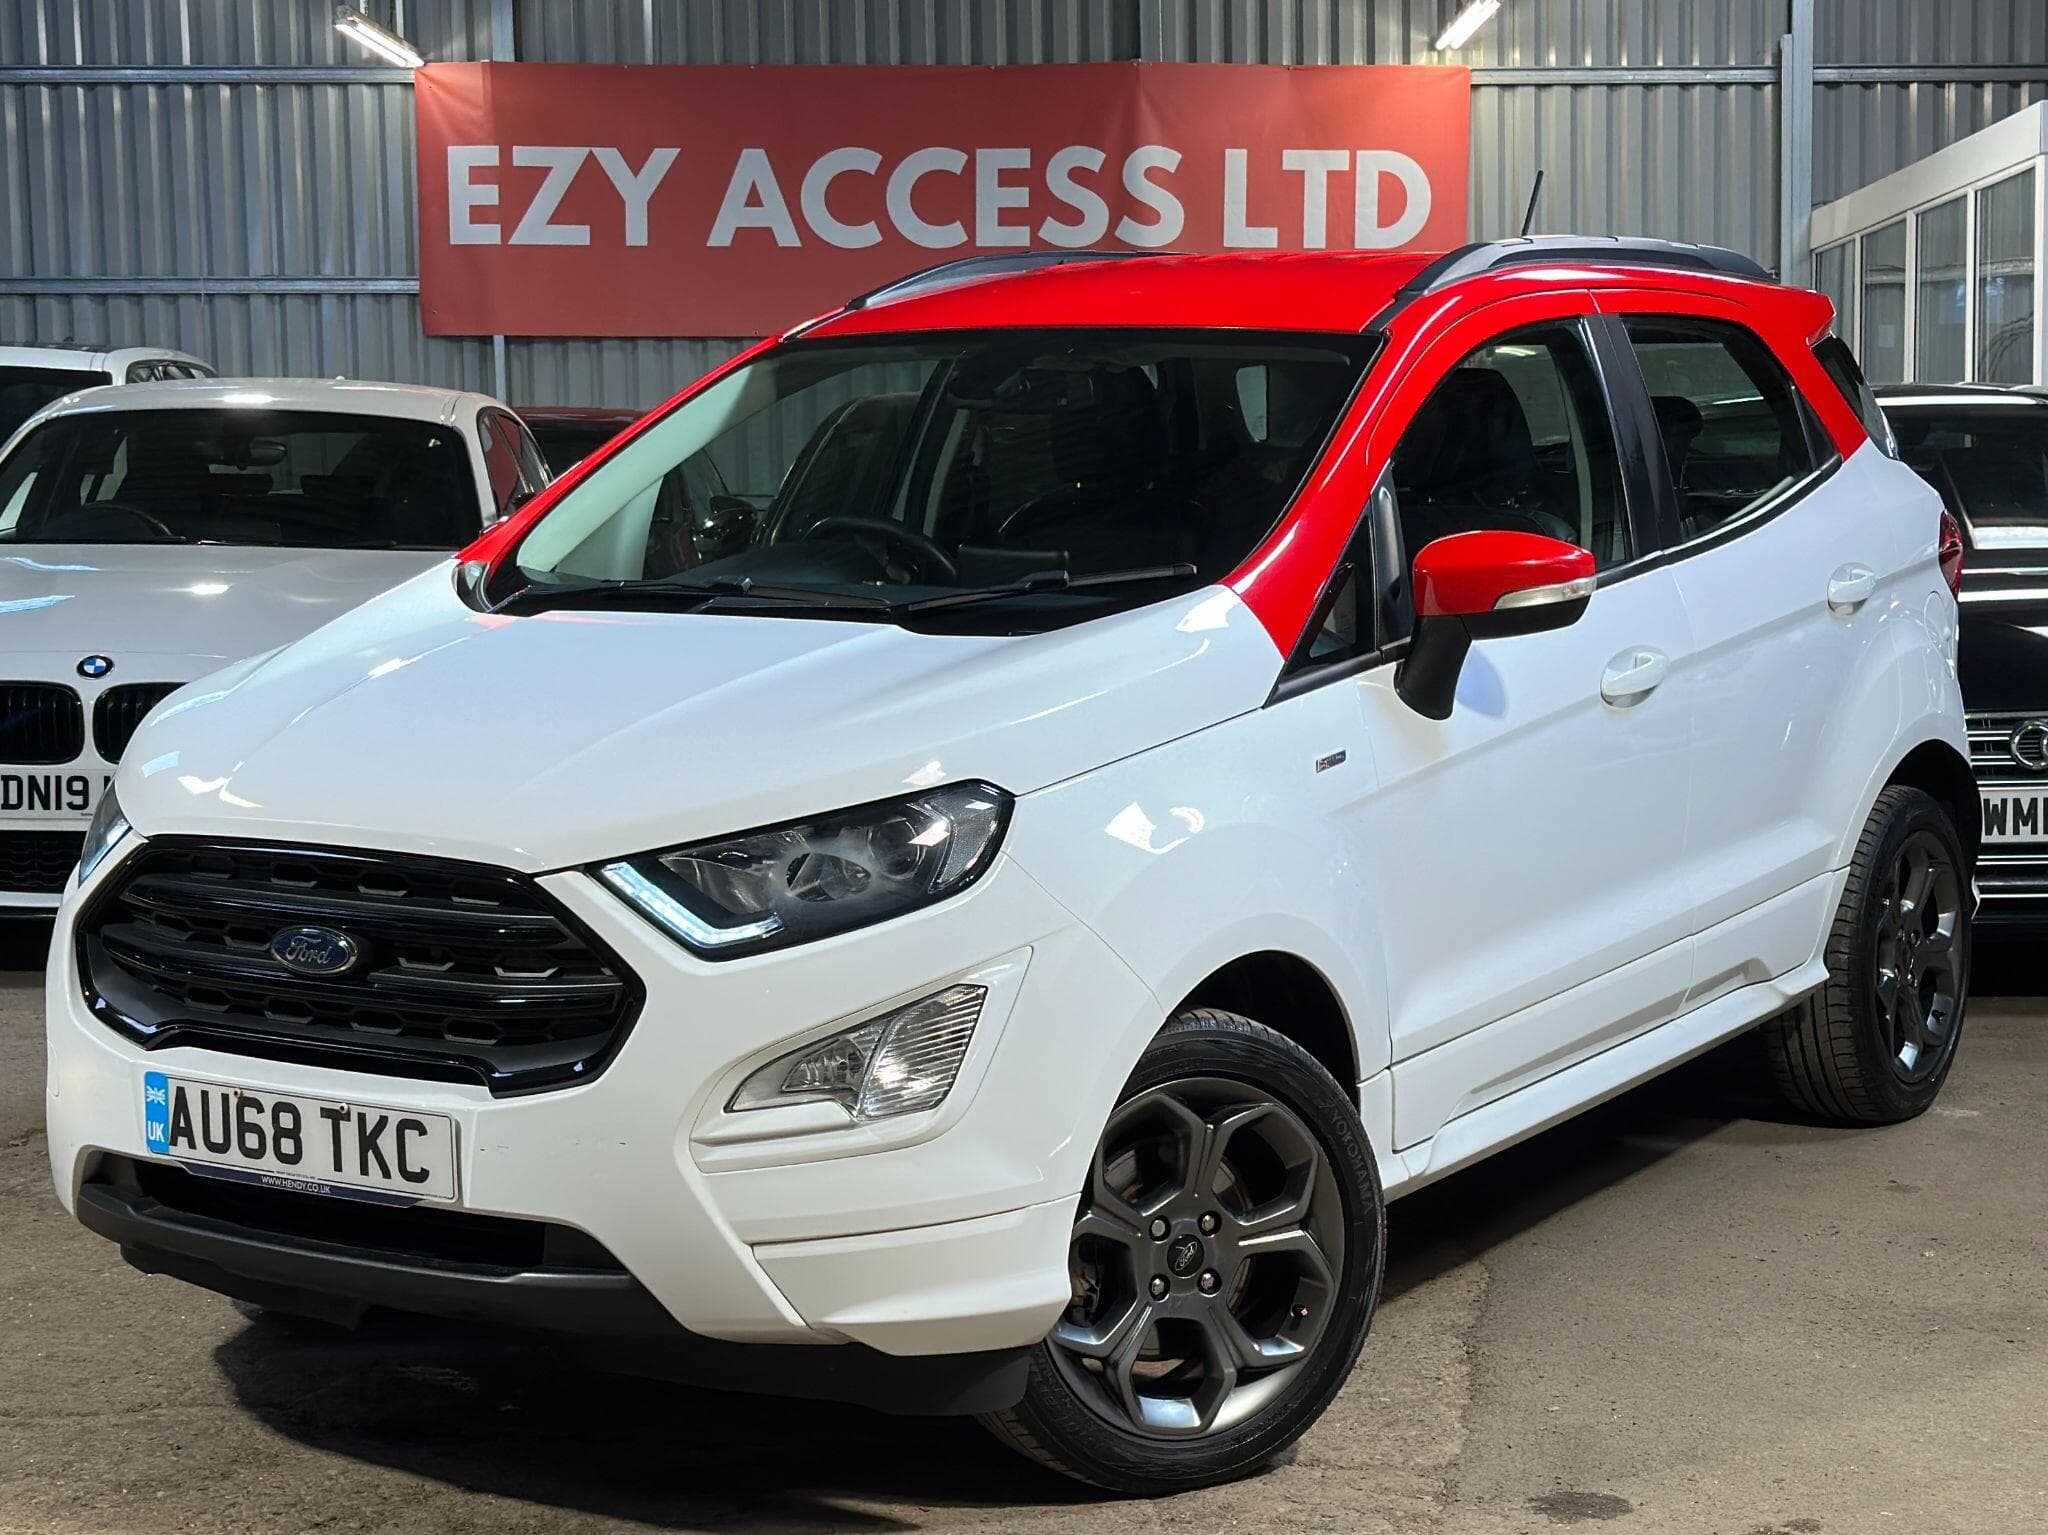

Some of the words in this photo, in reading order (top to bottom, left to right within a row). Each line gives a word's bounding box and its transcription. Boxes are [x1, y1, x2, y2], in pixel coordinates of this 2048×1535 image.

[447, 145, 680, 247] EZY
[706, 144, 1185, 249] ACCESS
[1223, 148, 1431, 249] LTD
[285, 935, 334, 964] Ford
[147, 1120, 165, 1143] UK
[169, 1085, 304, 1166] AU68
[320, 1106, 431, 1184] TKC
[260, 1175, 332, 1194] WWW.HENDY.CO.UK
